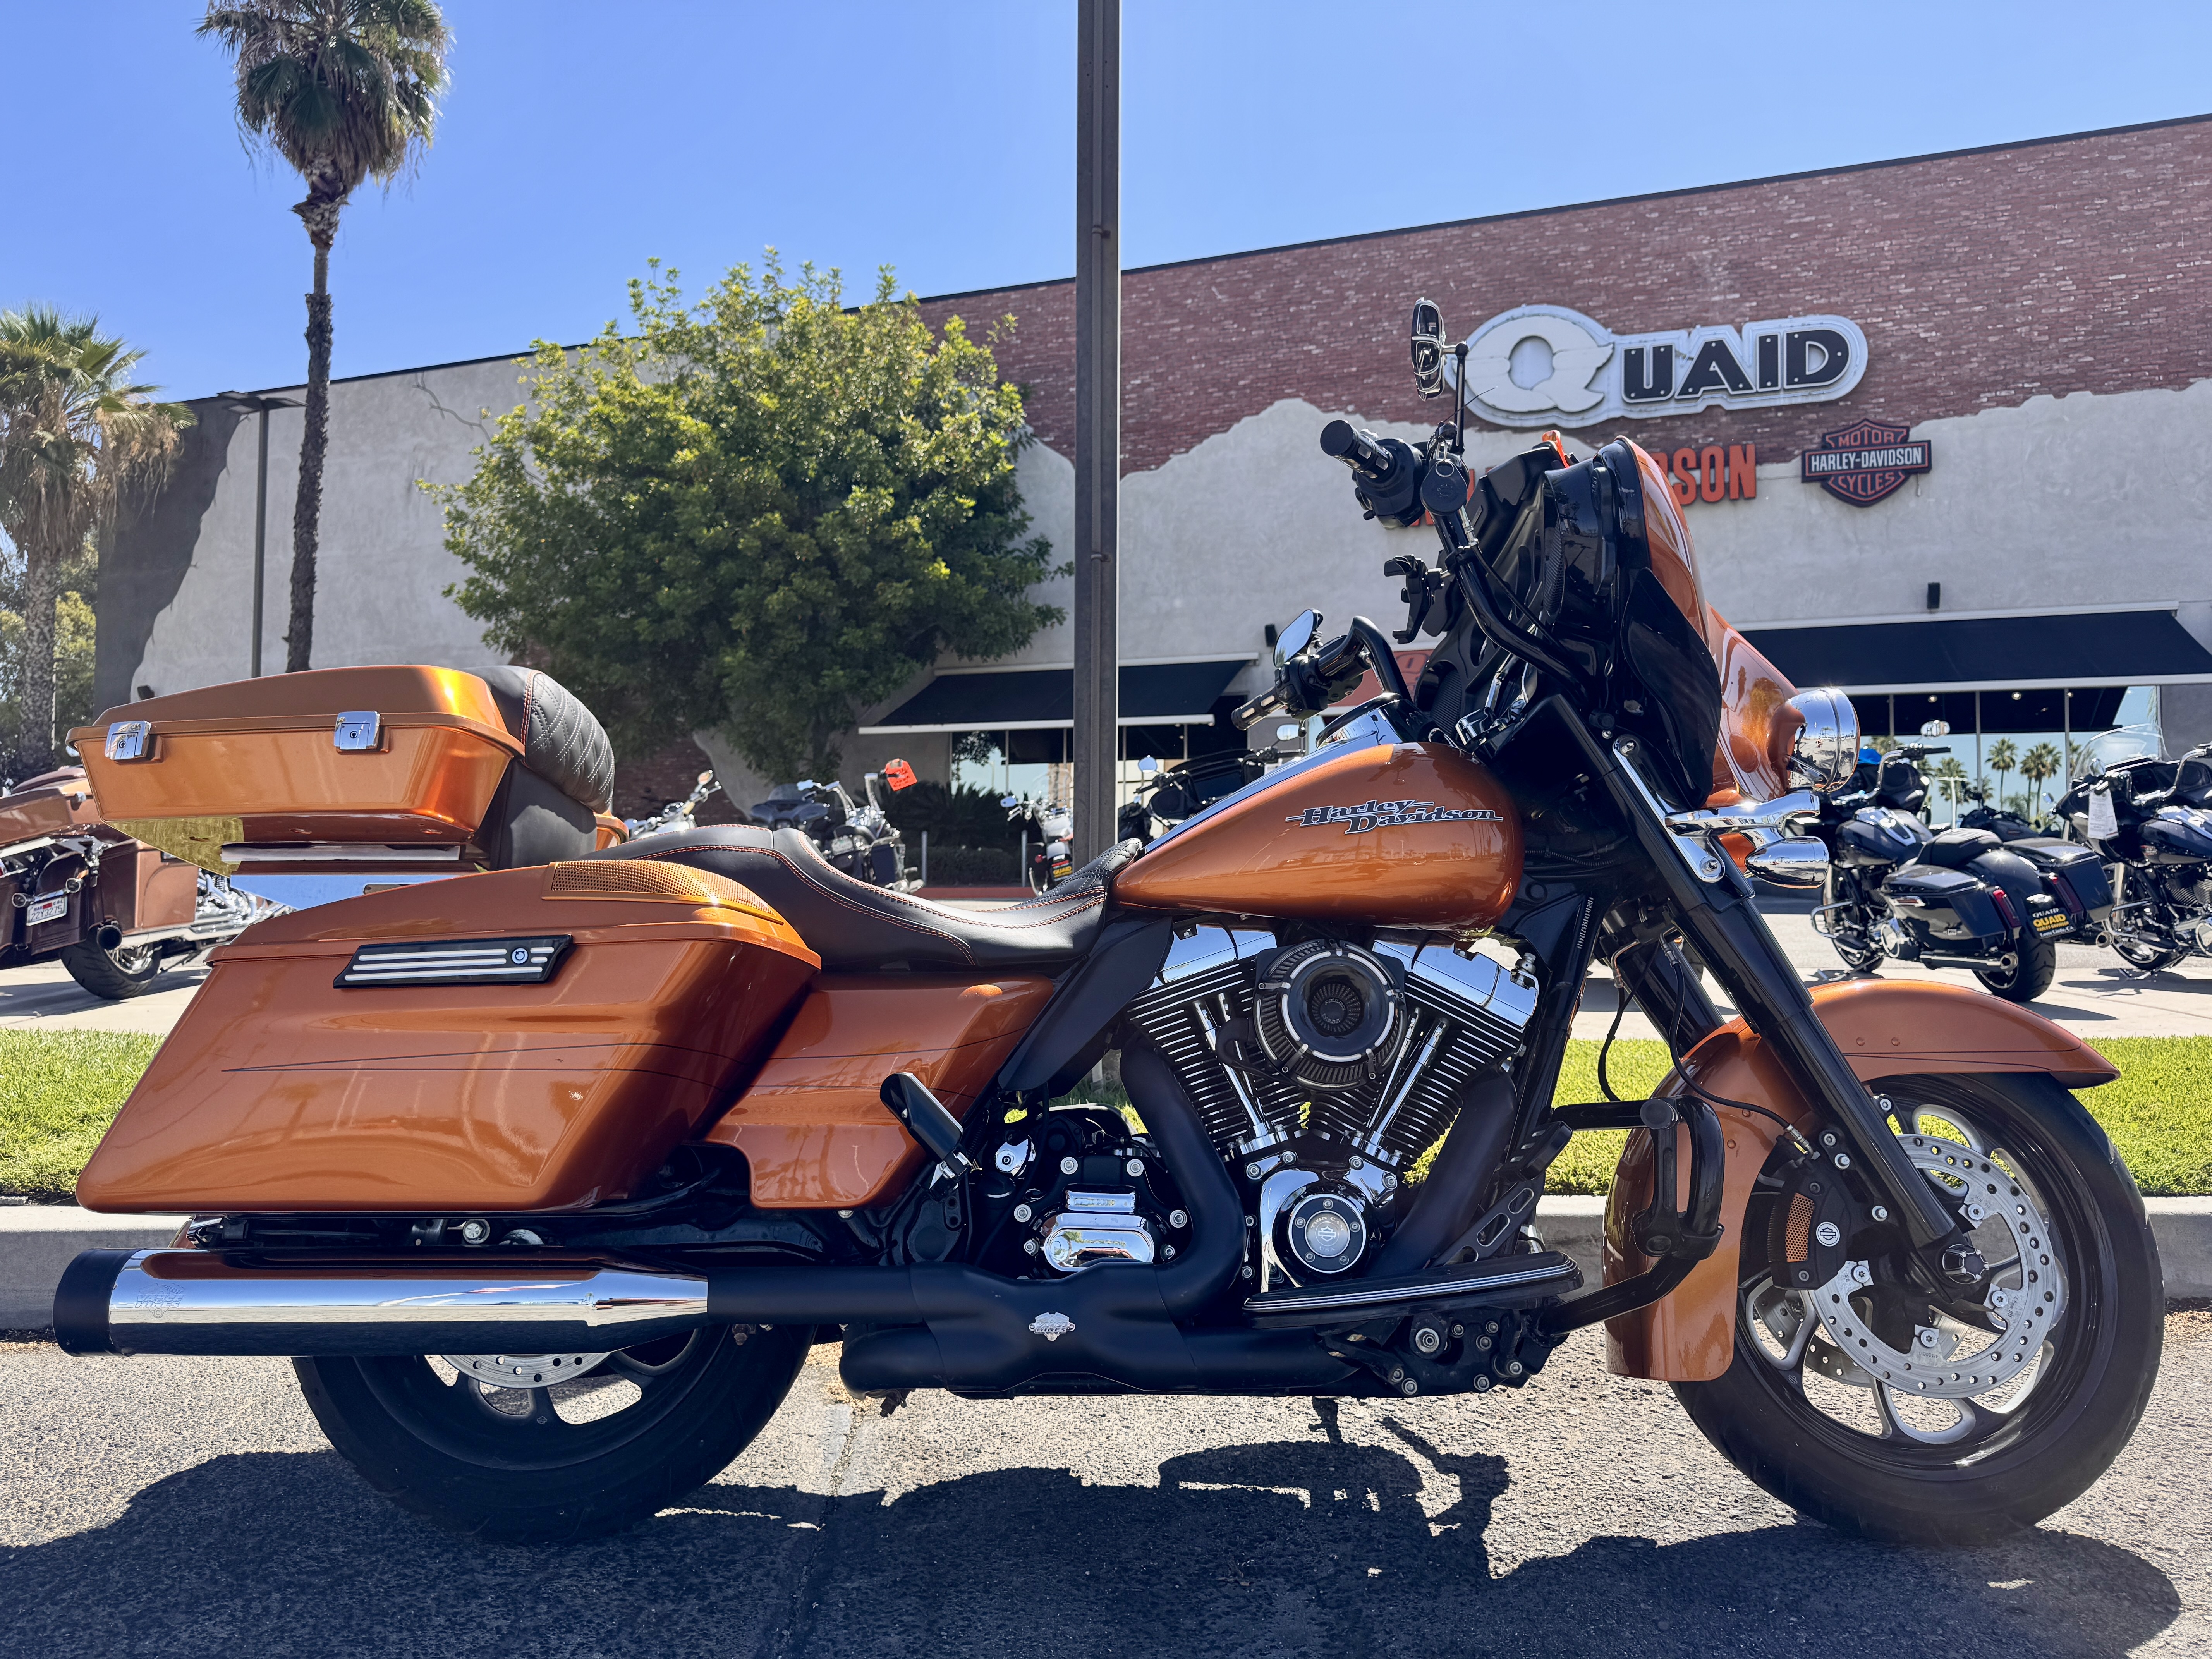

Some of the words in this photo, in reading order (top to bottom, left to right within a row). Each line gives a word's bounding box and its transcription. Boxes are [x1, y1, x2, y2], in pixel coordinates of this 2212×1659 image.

[1451, 315, 1851, 413] QUAID
[1839, 427, 1894, 447] MOTOR
[1812, 447, 1922, 472] HARLEY-DAVIDSON
[1838, 472, 1895, 496] CYCLES
[1299, 799, 1418, 827] Harley
[1345, 805, 1503, 834] Davidson
[31, 905, 62, 921] 22Y3275
[2032, 908, 2059, 918] QUAID
[2033, 914, 2066, 927] QUAID
[1310, 1216, 1327, 1228] TWIN
[1330, 1217, 1344, 1231] CAM
